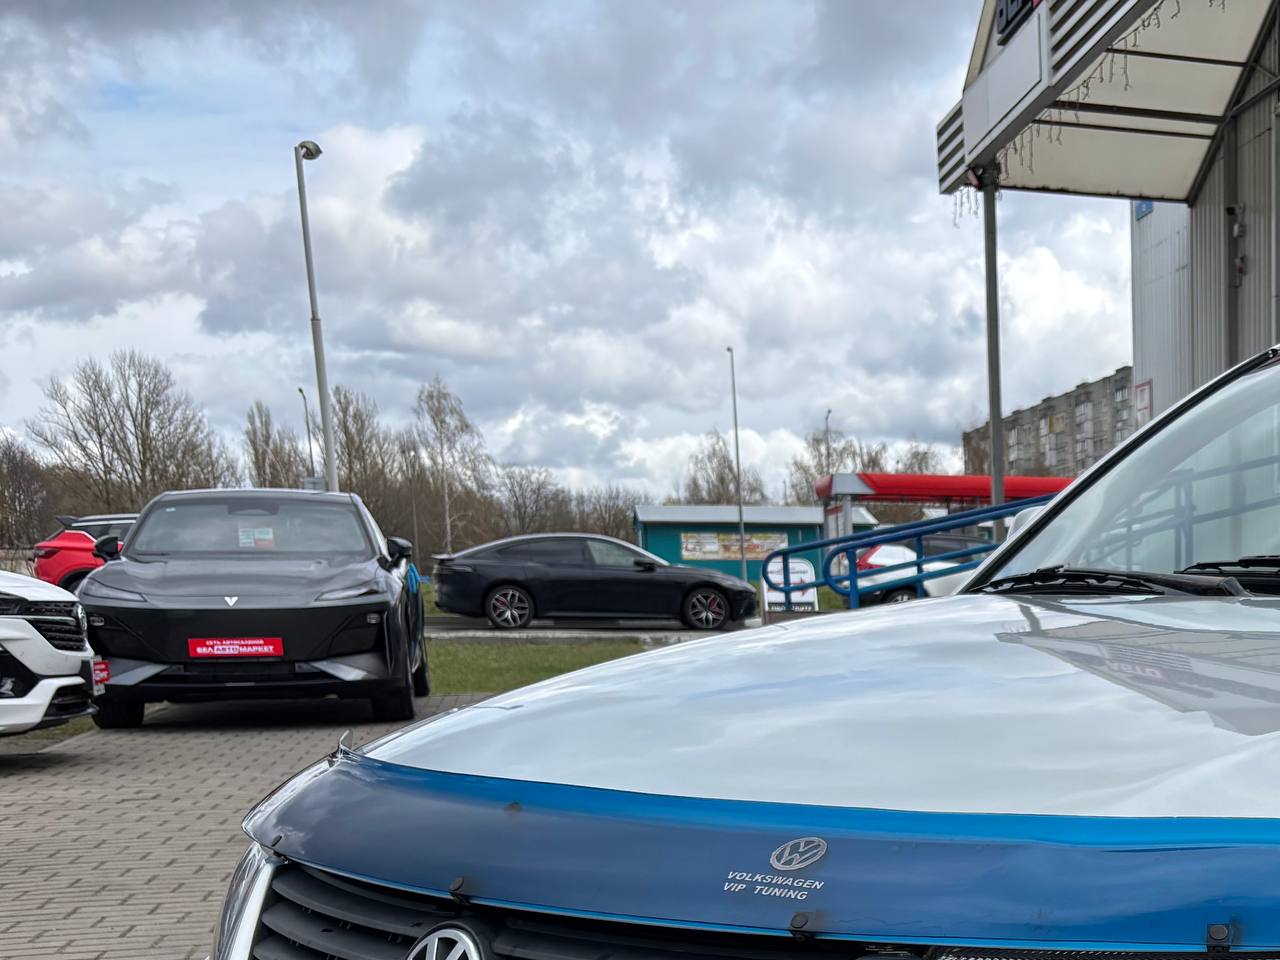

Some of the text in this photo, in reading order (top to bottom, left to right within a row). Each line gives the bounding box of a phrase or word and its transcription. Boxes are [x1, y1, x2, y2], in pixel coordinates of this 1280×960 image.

[727, 871, 825, 890] VOLKSWAGEN
[723, 882, 809, 900] VIP TUNING
